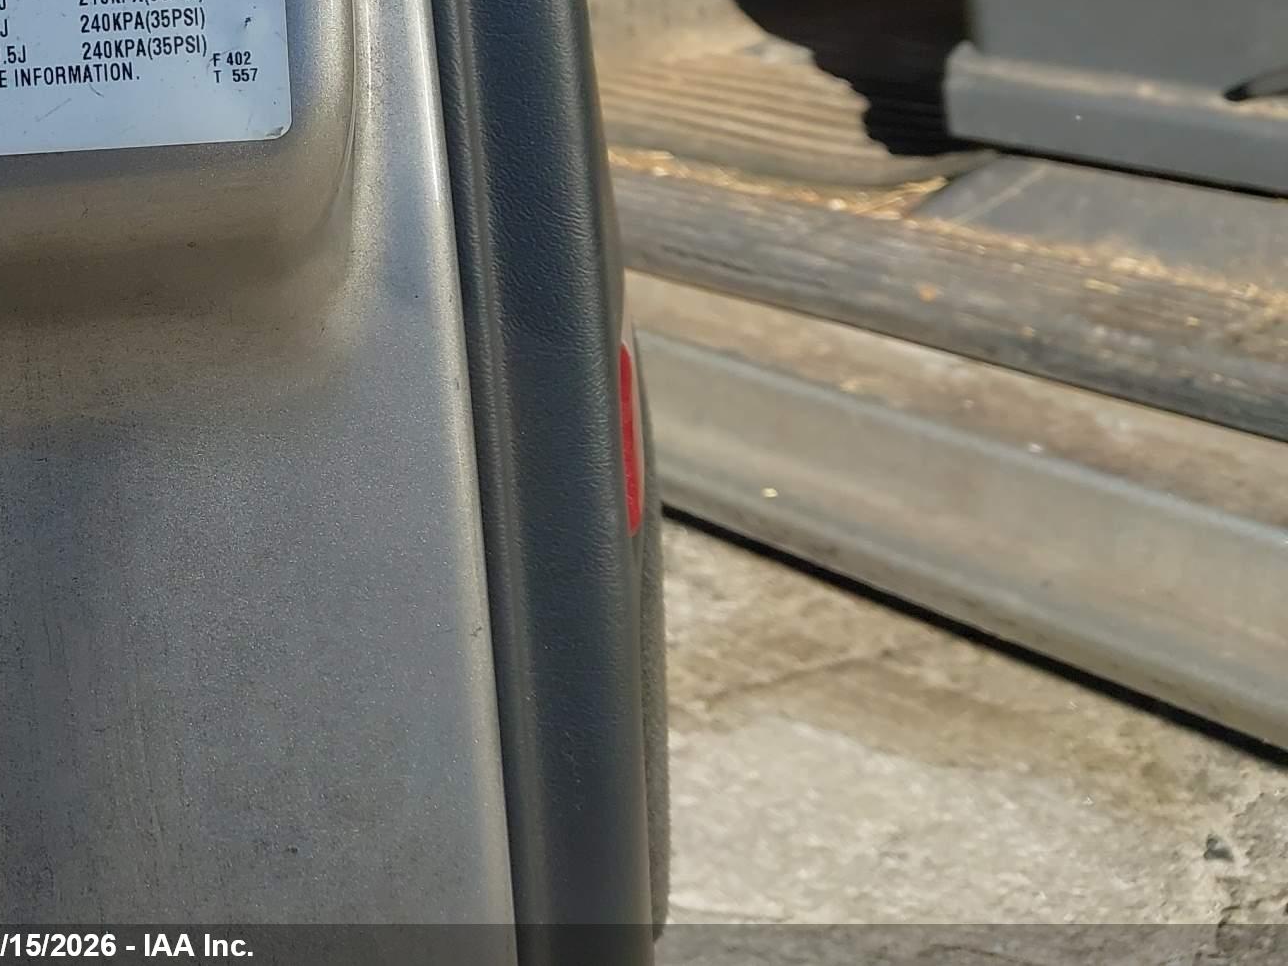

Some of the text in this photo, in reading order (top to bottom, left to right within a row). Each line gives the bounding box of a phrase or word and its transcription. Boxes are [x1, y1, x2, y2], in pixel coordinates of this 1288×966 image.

[80, 7, 205, 34] 240KPA(35PSI)
[82, 34, 207, 60] 240KPA(35PSI)
[213, 51, 251, 67] F 402
[15, 62, 139, 87] INFORMATION.
[213, 68, 258, 83] T 557
